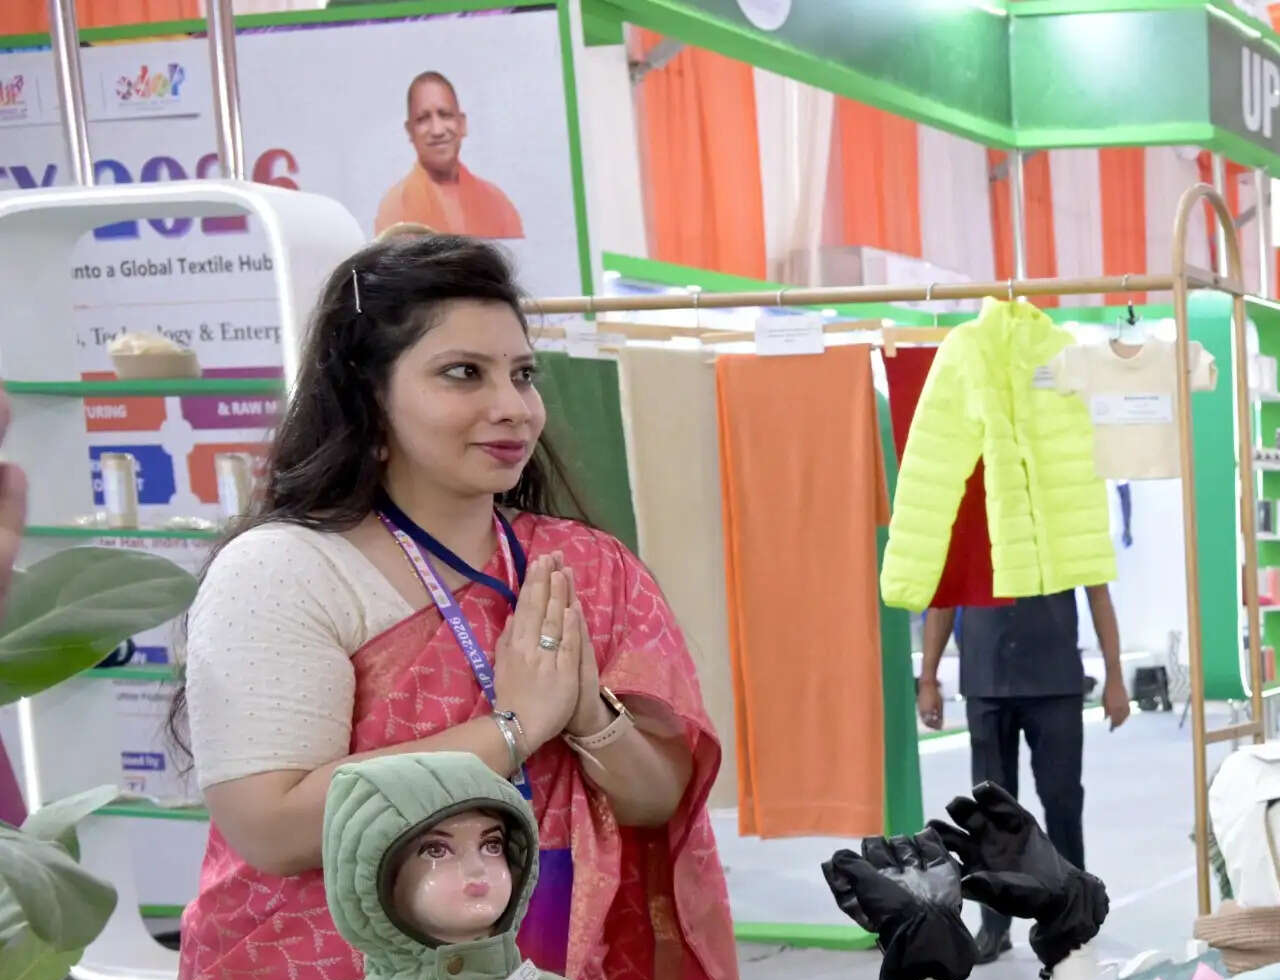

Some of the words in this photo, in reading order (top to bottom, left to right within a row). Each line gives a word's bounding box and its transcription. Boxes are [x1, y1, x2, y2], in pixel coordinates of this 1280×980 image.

[1241, 45, 1280, 138] UP
[106, 265, 116, 278] a
[120, 259, 173, 278] Global
[177, 256, 233, 274] Textile
[238, 254, 274, 272] Hub
[199, 323, 214, 342] &
[231, 401, 262, 415] RAW
